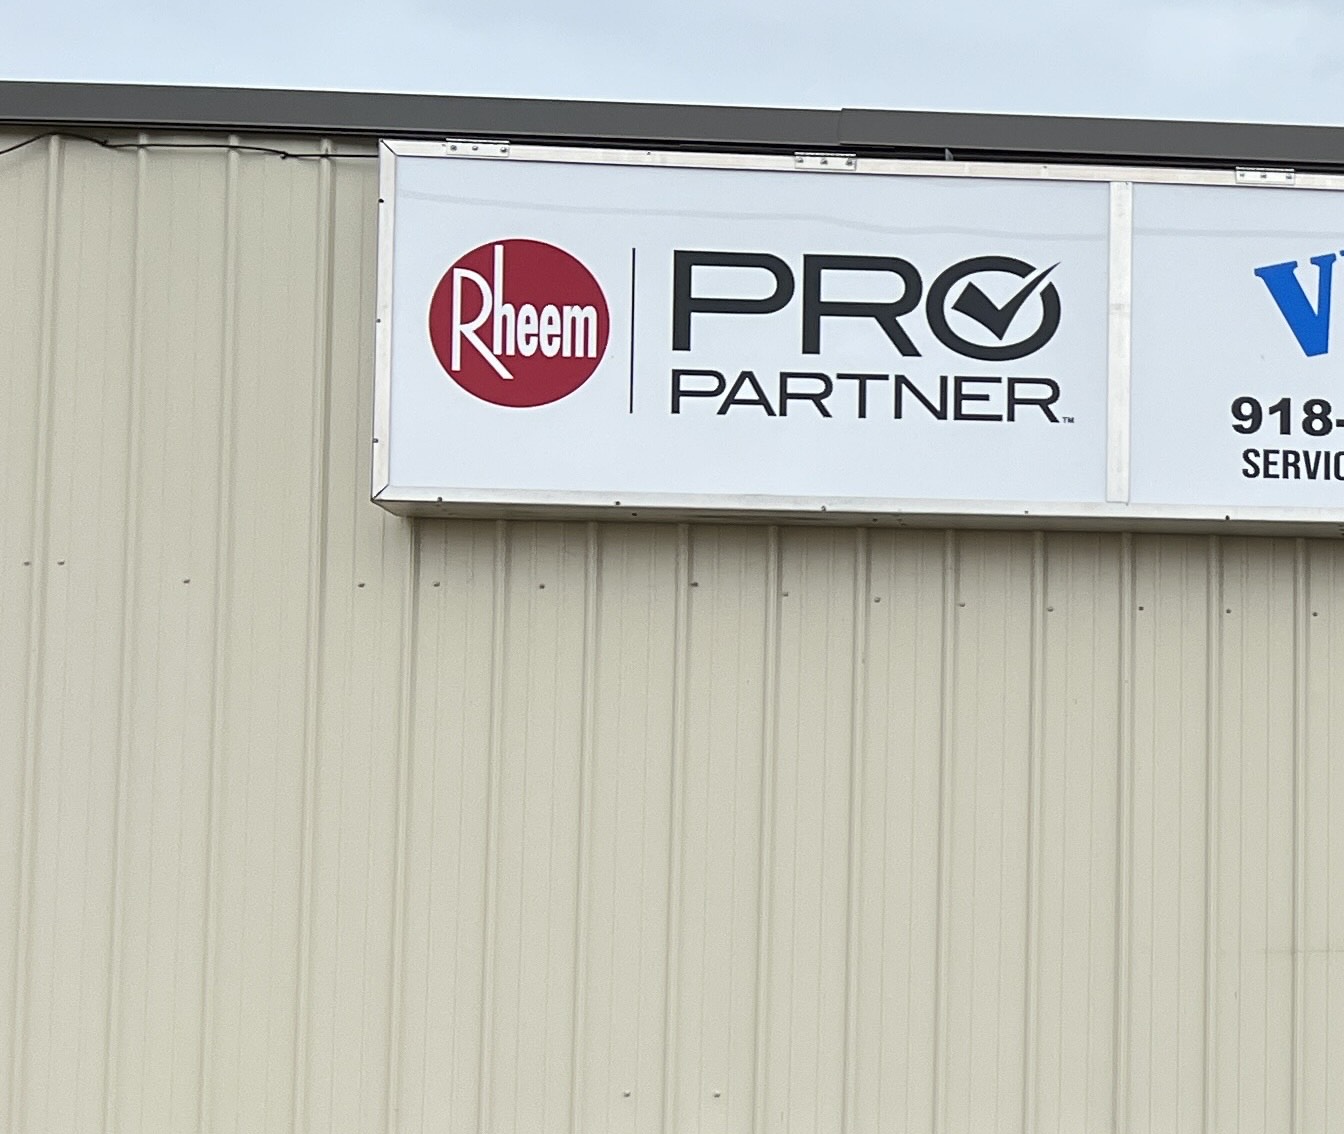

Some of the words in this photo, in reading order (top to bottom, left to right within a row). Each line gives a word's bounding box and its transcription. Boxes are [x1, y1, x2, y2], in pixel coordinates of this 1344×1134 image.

[450, 244, 598, 381] Rheem
[671, 249, 1062, 362] PRO
[670, 368, 1060, 424] PARTNER
